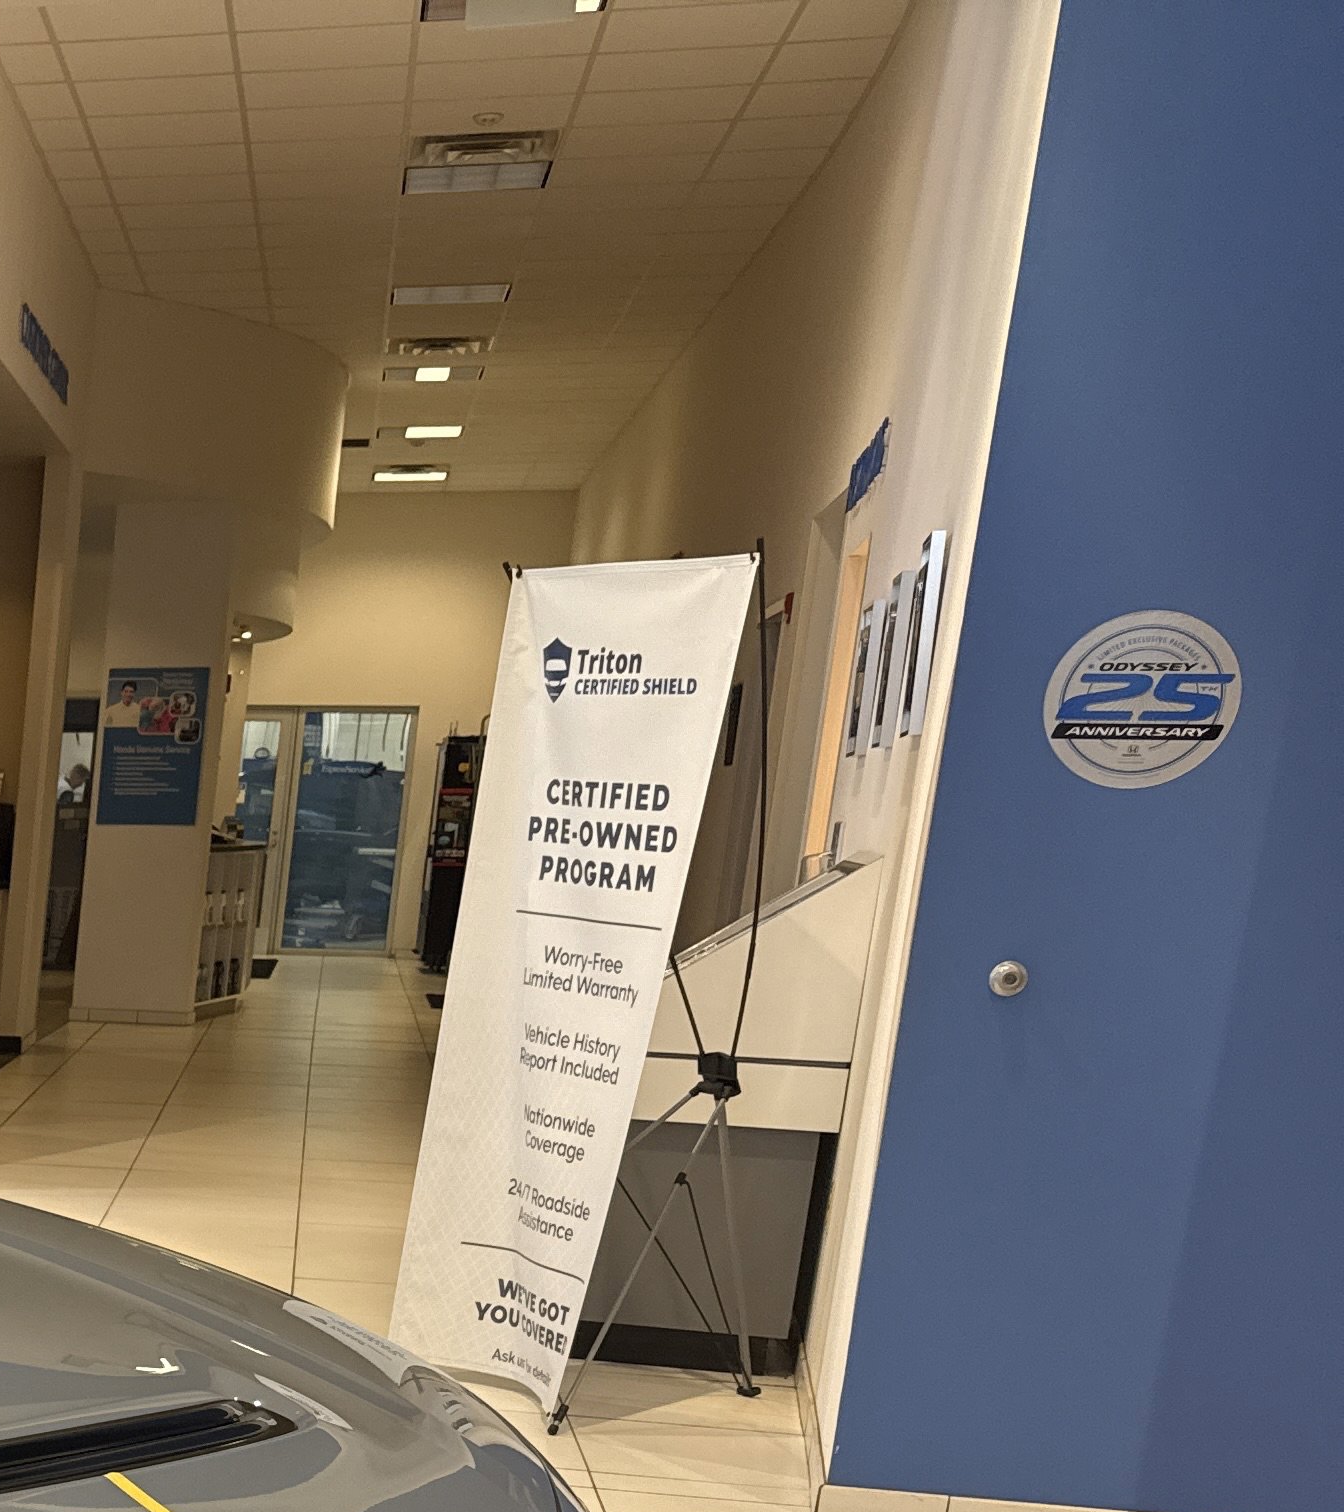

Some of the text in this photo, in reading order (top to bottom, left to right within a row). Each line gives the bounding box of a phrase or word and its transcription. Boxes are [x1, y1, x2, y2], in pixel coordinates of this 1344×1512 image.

[577, 646, 643, 675] Triton
[1099, 662, 1200, 672] ODYSSEY
[574, 677, 697, 695] CERTIFIED SHIELD
[1055, 673, 1236, 722] 25
[1064, 726, 1211, 738] ANNIVERSARY
[546, 778, 671, 812] CERTIFIED
[528, 816, 678, 853] PRE-OWNED
[539, 855, 657, 893] PROGRAM
[544, 944, 624, 974] Worry-Free
[523, 966, 640, 1009] Limited Warranty
[524, 1022, 622, 1064] Vehicle History
[519, 1046, 620, 1086] Report Included
[523, 1103, 596, 1138] Nationwide
[525, 1129, 585, 1164] Coverage
[531, 1187, 591, 1221] Roadside
[517, 1205, 574, 1242] Assistance
[474, 1301, 520, 1328] YOU
[538, 1298, 571, 1326] GOT
[491, 1347, 516, 1365] Ask
